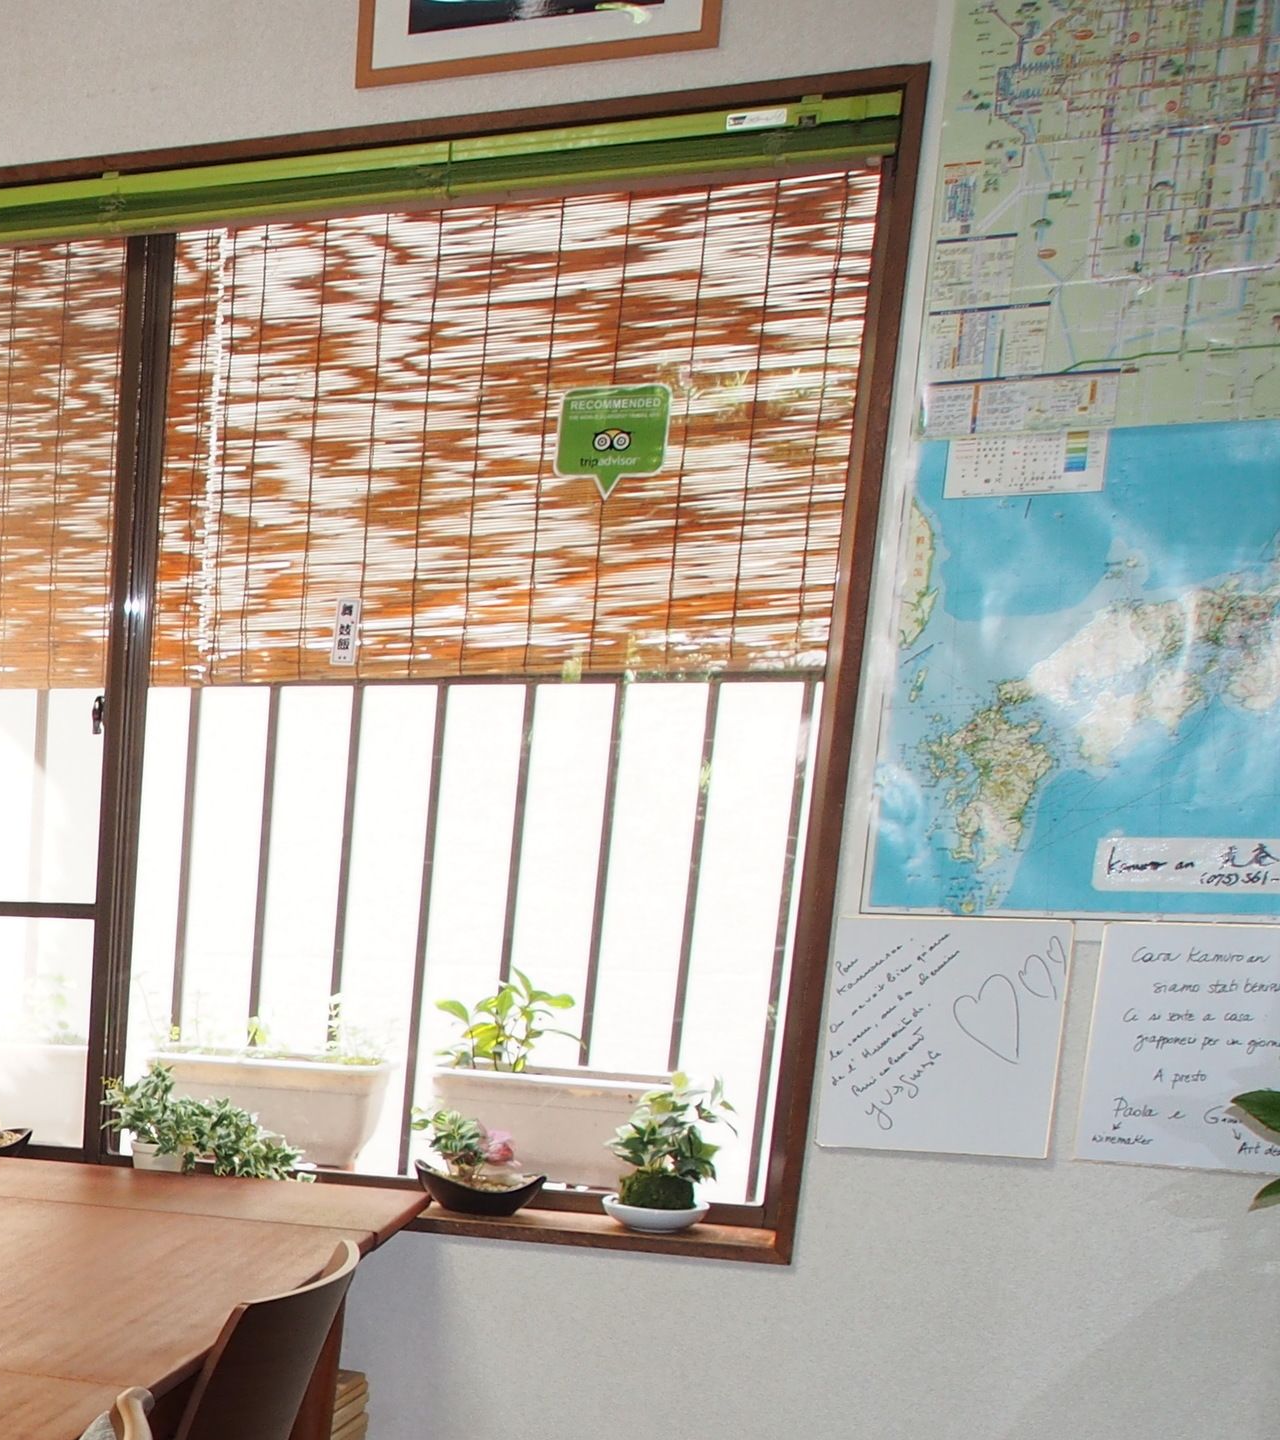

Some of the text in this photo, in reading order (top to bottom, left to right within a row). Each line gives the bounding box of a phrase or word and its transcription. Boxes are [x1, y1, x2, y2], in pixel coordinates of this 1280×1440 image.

[570, 397, 661, 411] RECOMMENDED
[580, 455, 637, 468] tripadvisor
[1175, 860, 1195, 870] an
[1131, 946, 1182, 964] Cara
[1153, 982, 1200, 993] siamo
[1202, 1013, 1215, 1022] a
[1223, 1013, 1255, 1022] casa
[1153, 1069, 1207, 1089] A presto
[1113, 1096, 1159, 1118] Paola
[1092, 1135, 1154, 1146] winemaker
